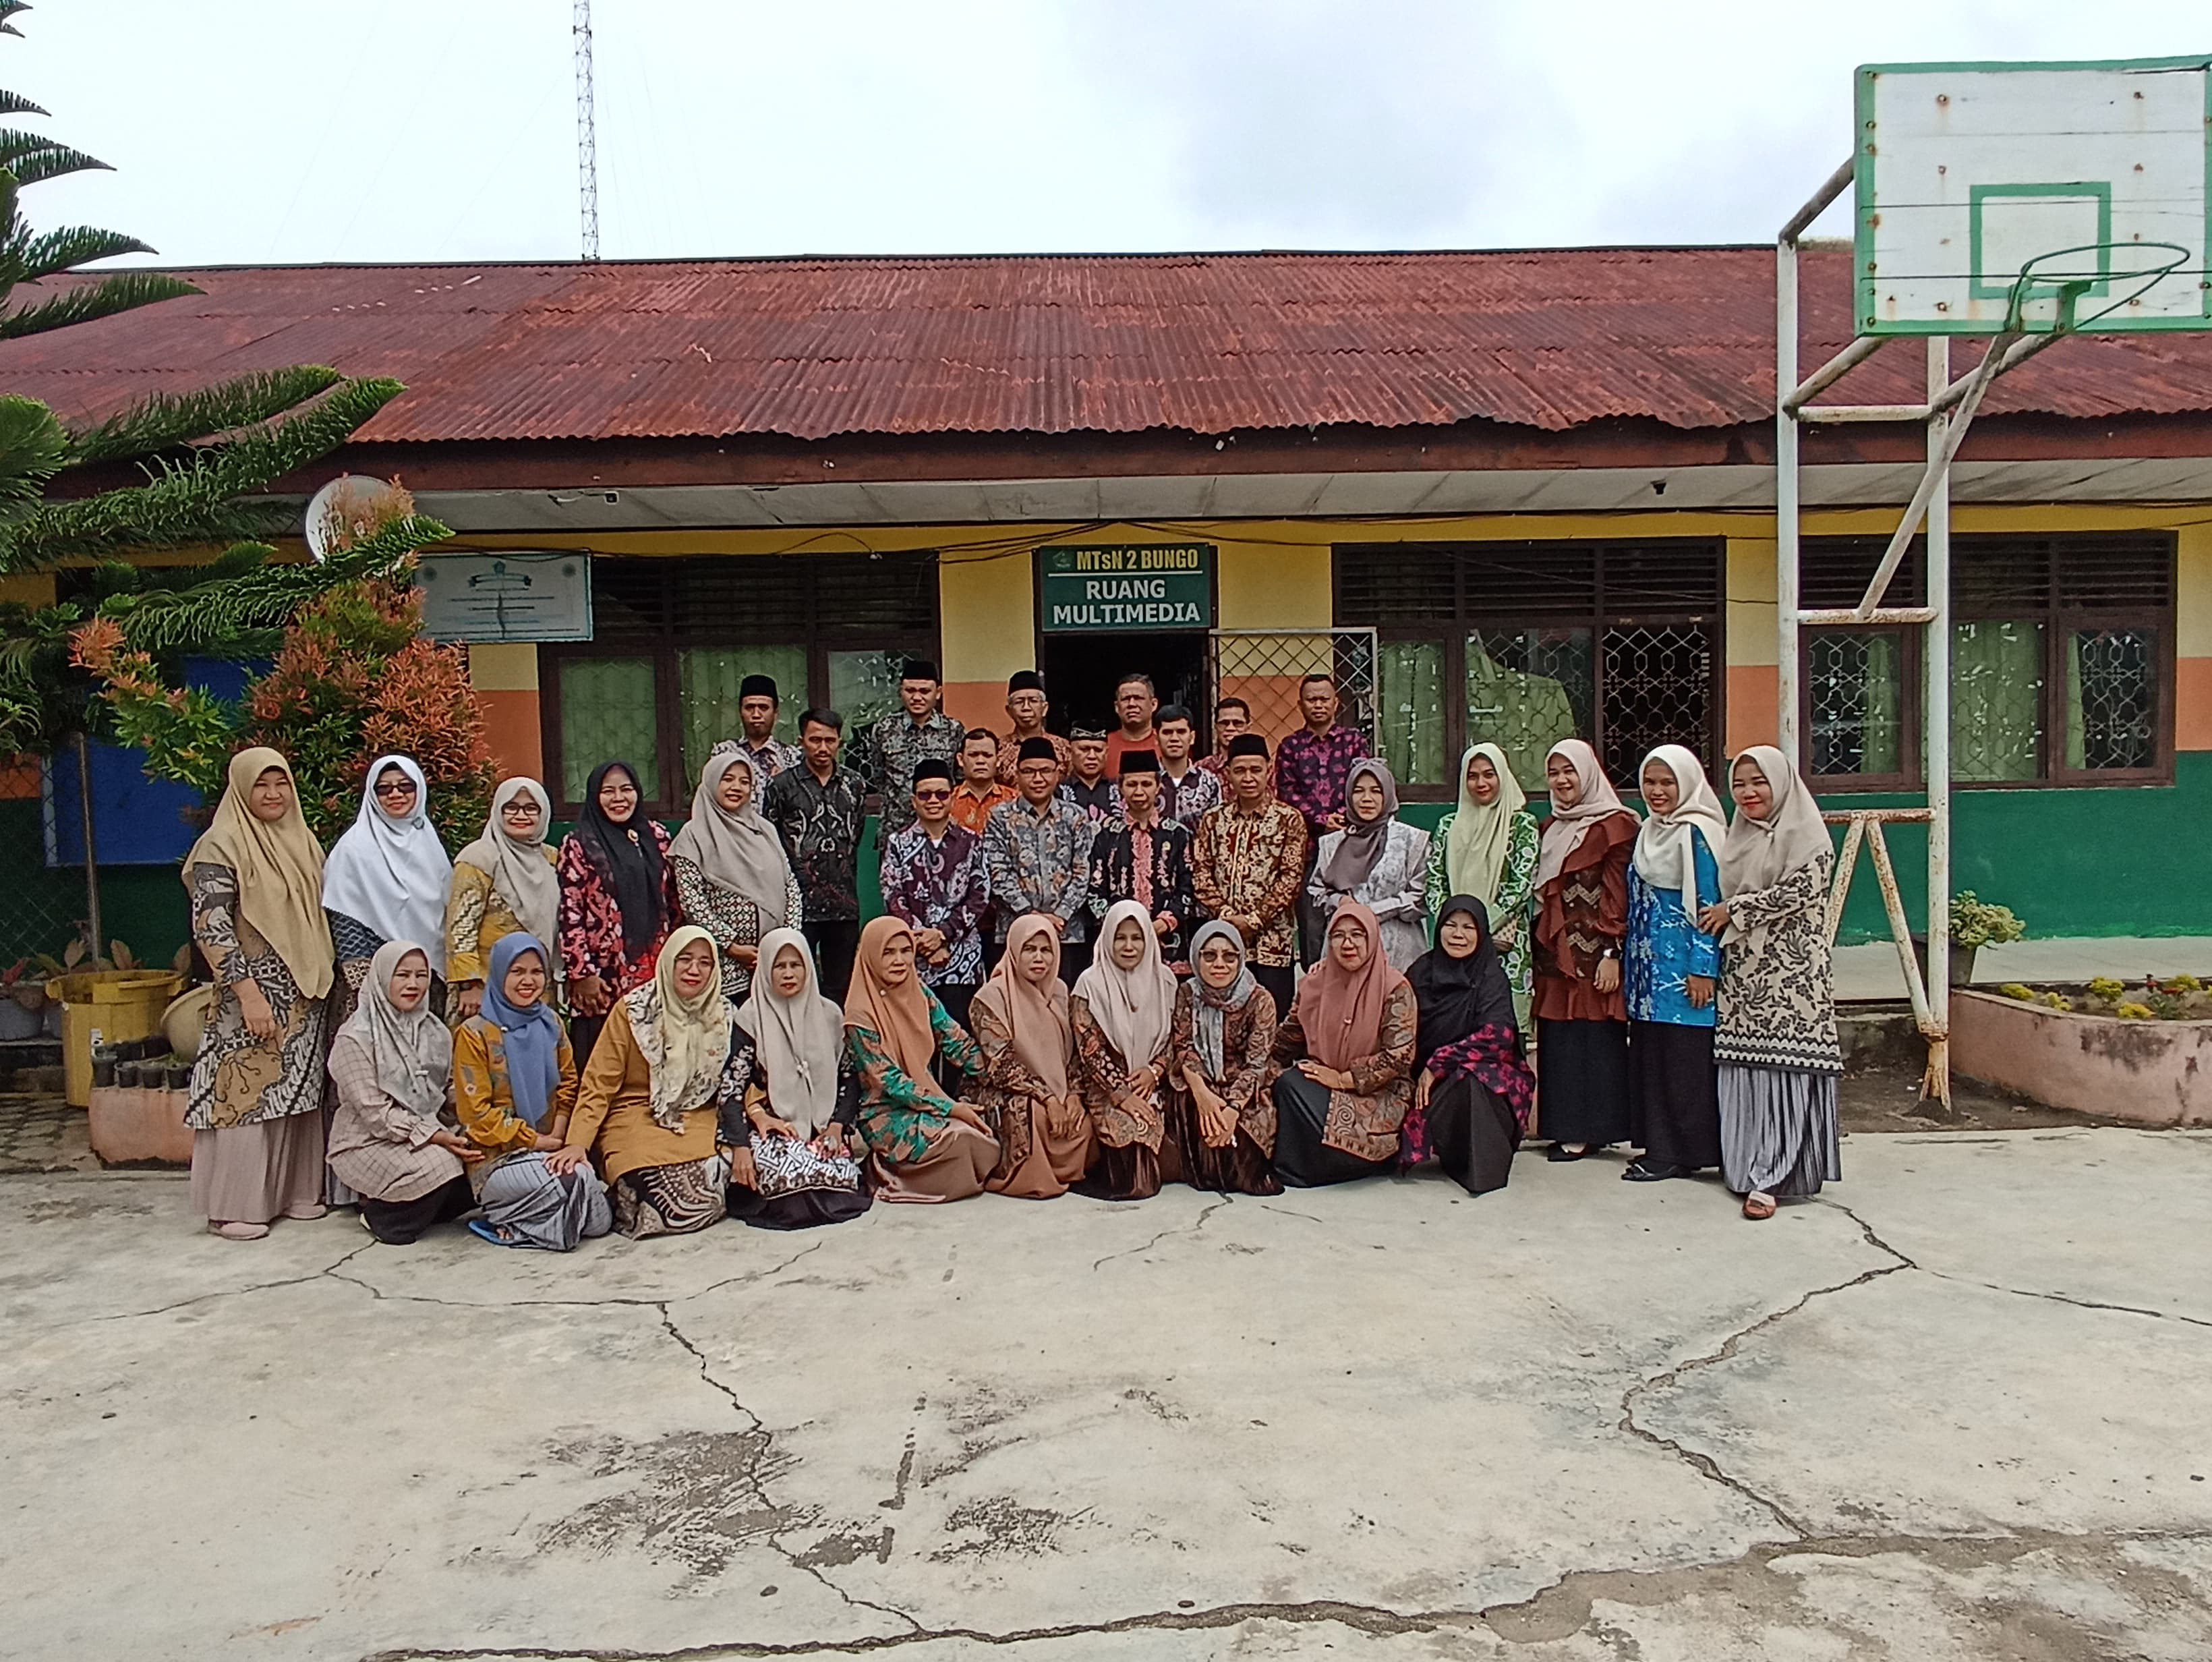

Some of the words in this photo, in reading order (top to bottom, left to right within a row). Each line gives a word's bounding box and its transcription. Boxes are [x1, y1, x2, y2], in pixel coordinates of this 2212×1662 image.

[1076, 550, 1122, 570] MTsN
[1126, 550, 1137, 569] 2
[1141, 549, 1198, 569] BUNGO
[1086, 579, 1165, 600] RUANG
[1053, 602, 1200, 625] MULTIMEDIA
